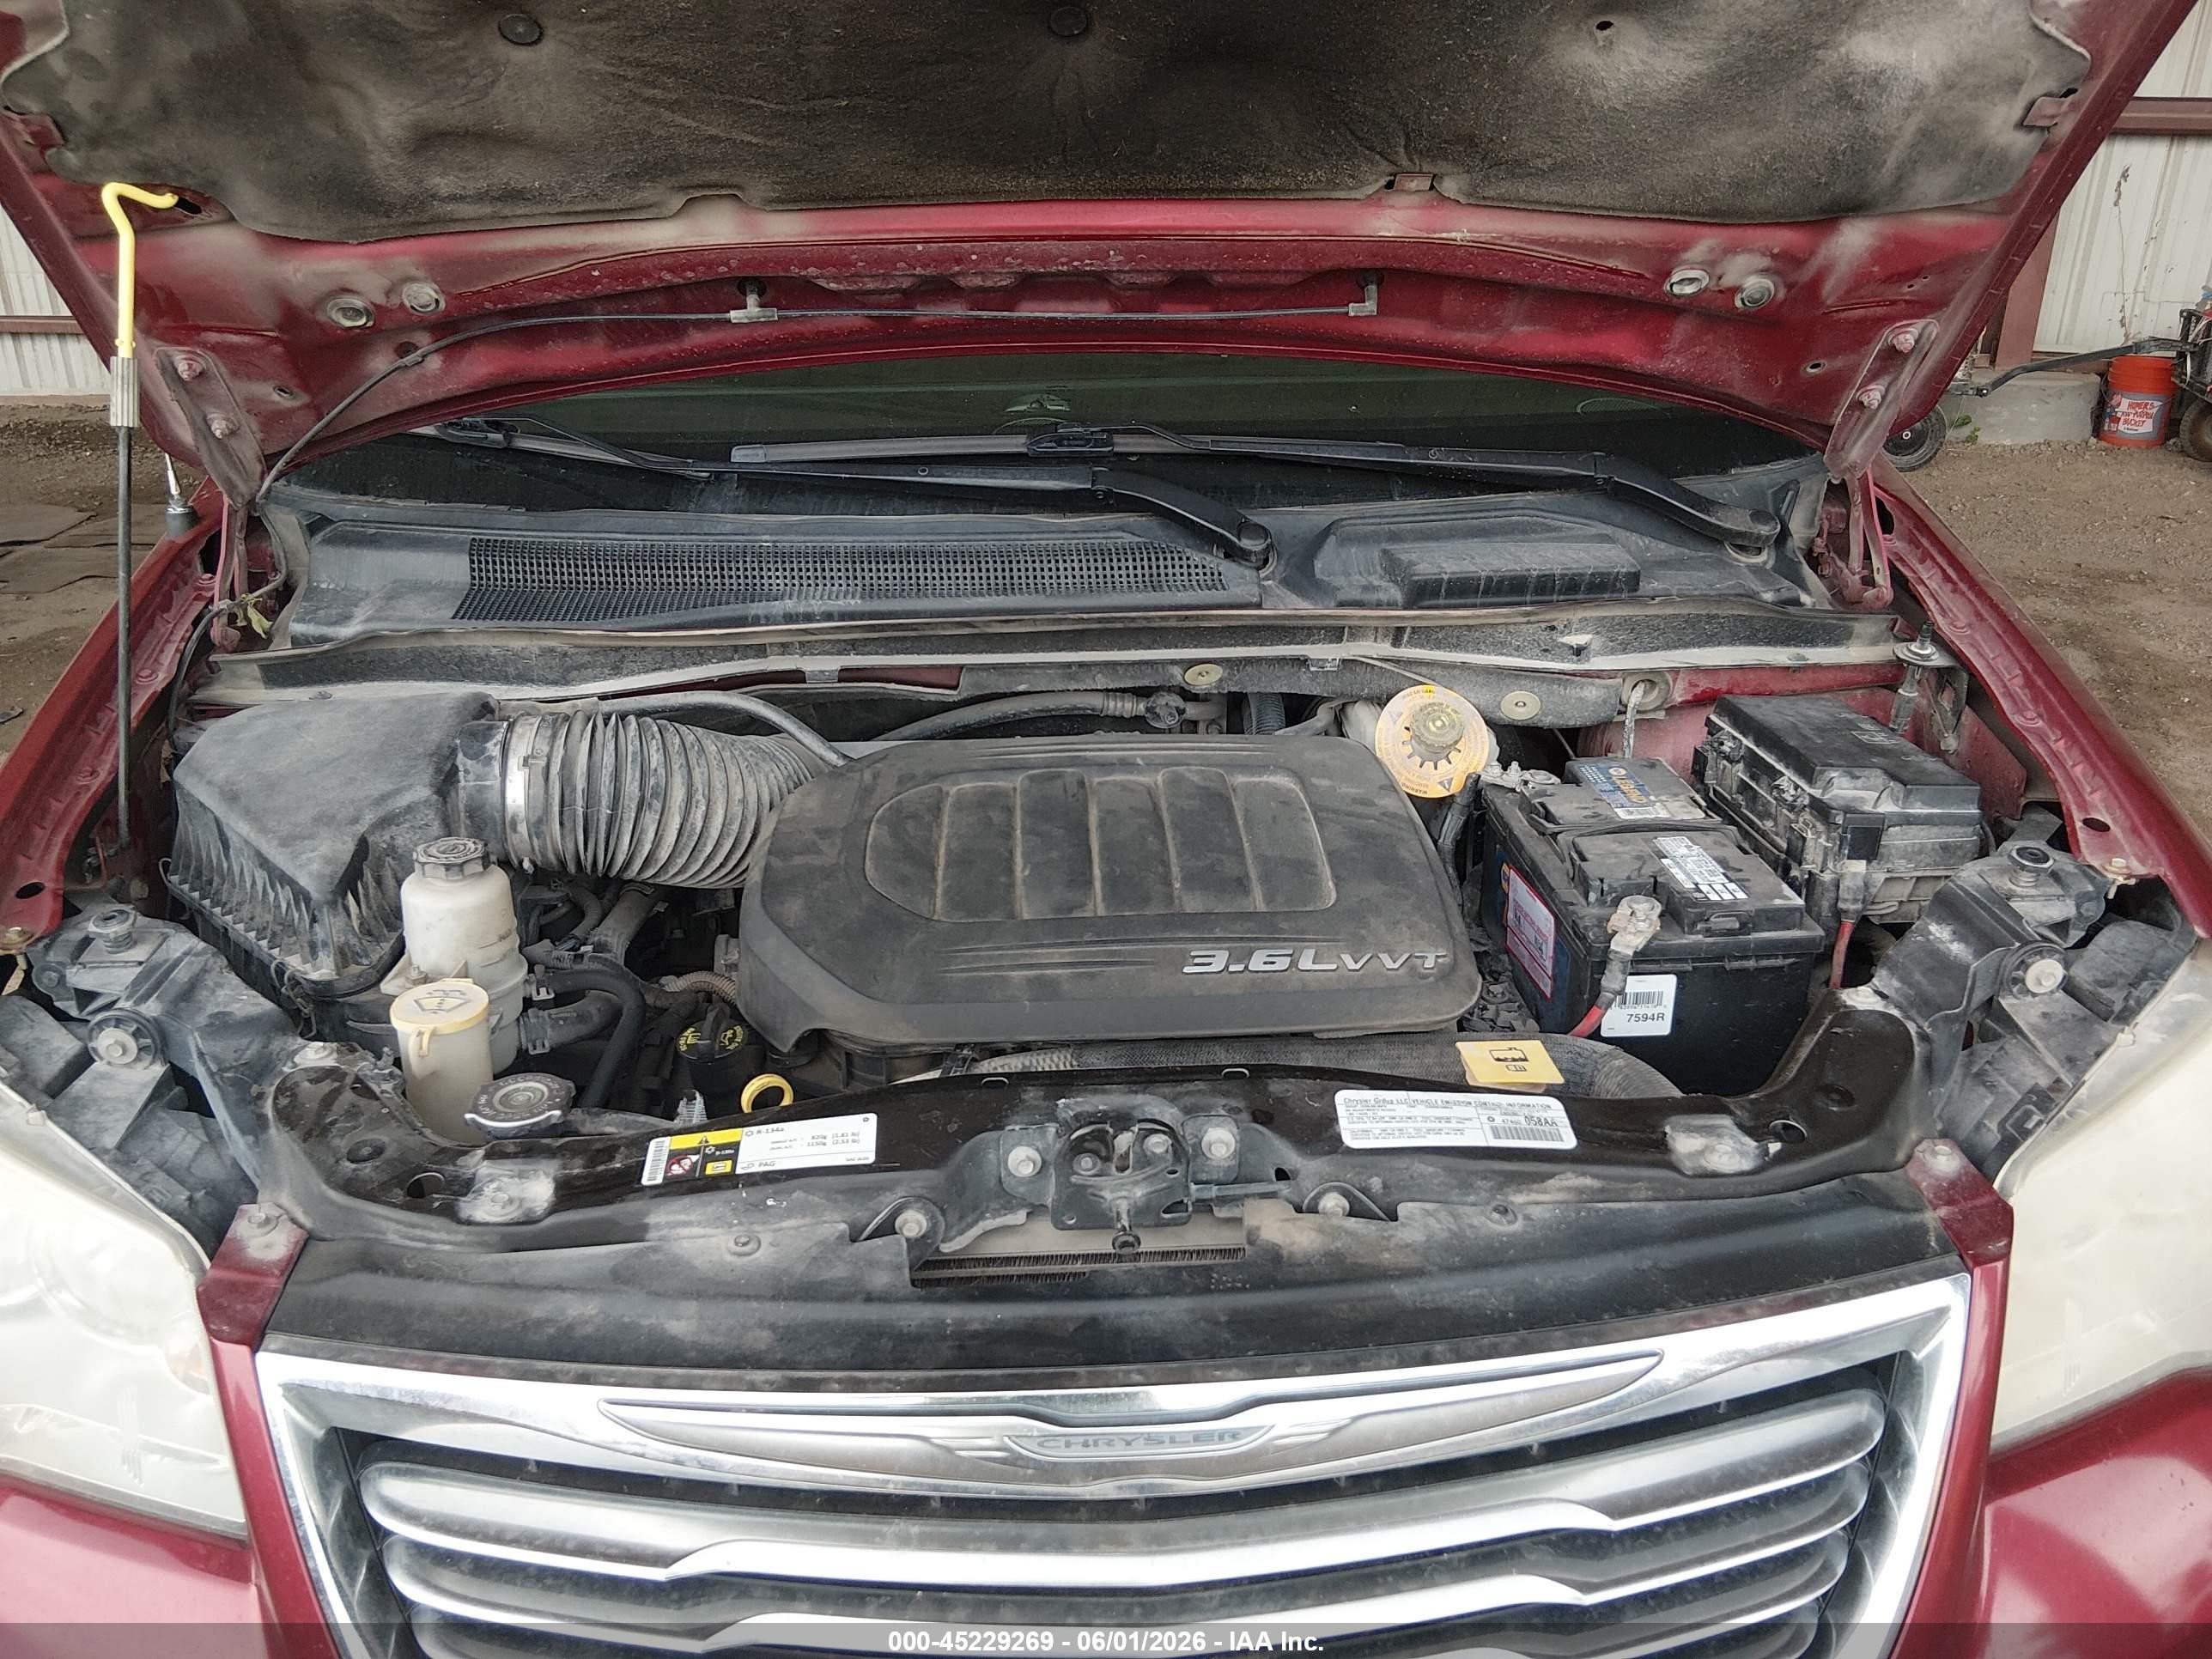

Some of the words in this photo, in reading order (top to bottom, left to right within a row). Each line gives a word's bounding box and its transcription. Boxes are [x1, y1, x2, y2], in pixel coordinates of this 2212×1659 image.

[1626, 1012, 1665, 1023] 7594R
[758, 1160, 776, 1169] PAG
[1036, 1431, 1242, 1449] CHRYSLER
